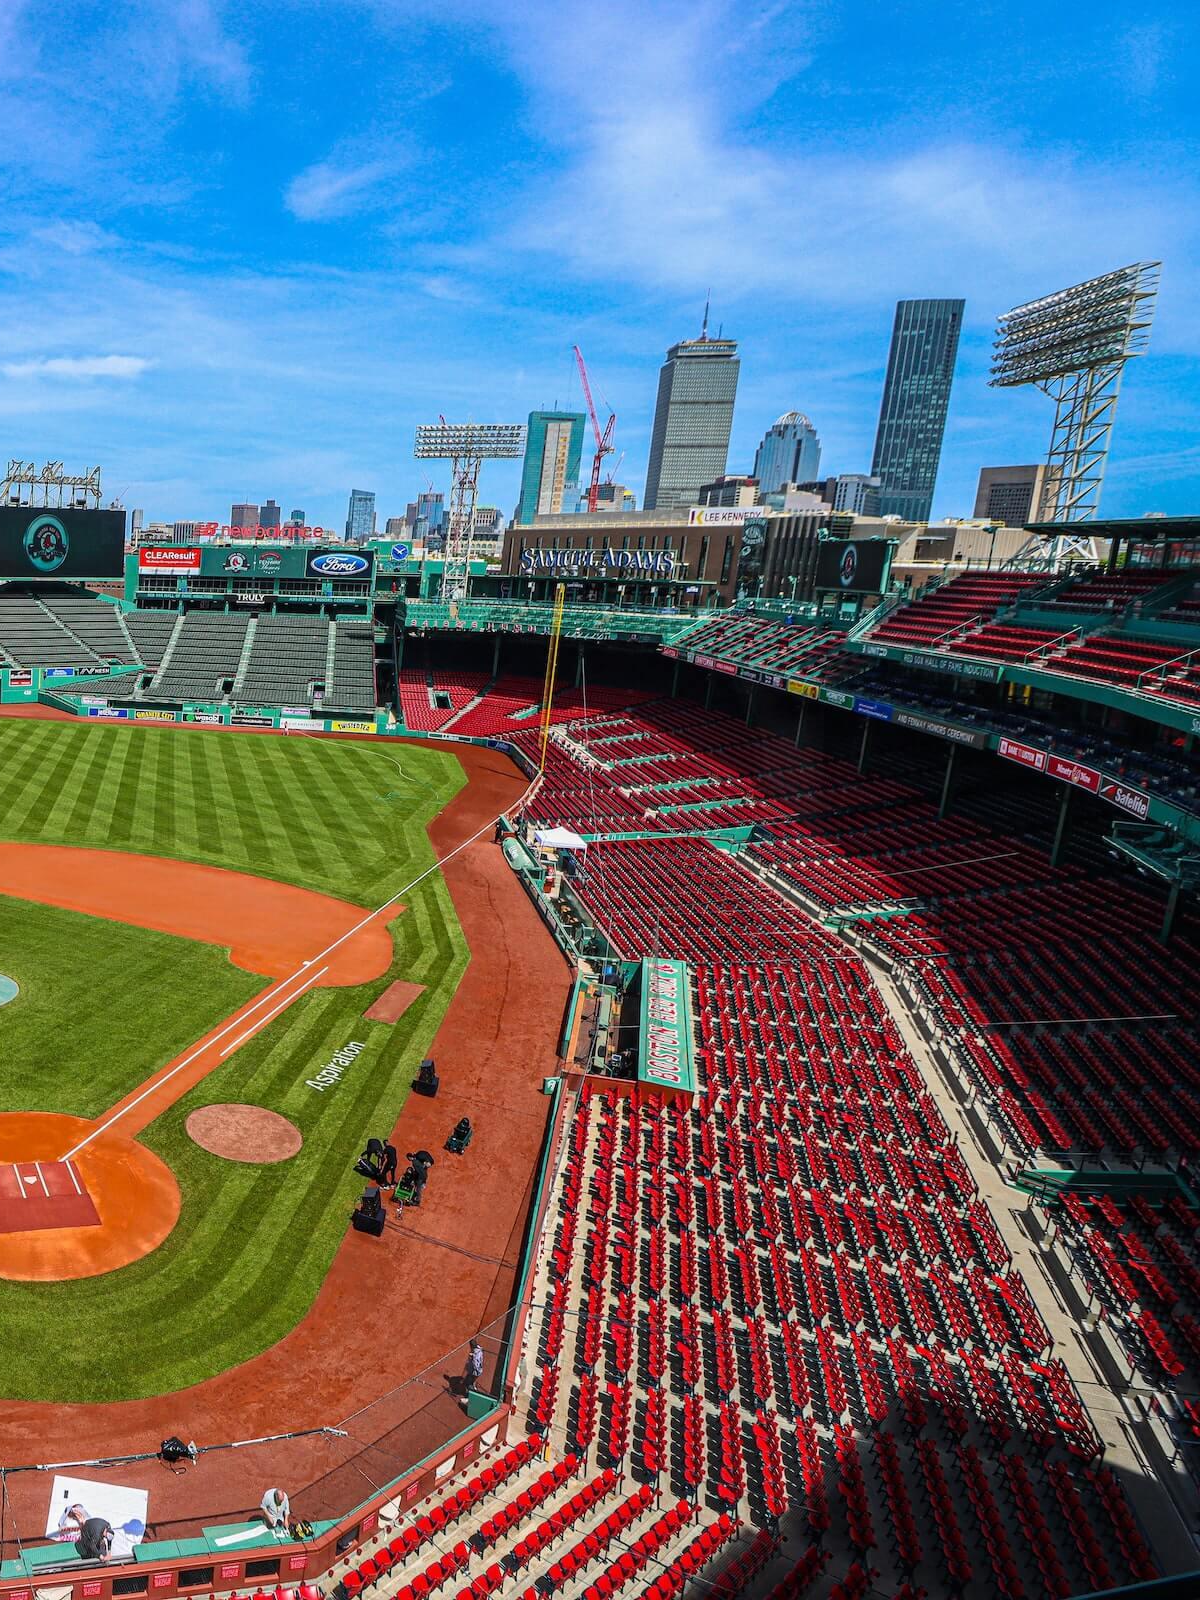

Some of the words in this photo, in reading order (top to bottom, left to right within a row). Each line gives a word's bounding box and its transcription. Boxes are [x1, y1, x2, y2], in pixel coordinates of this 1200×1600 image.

[704, 512, 719, 522] LEE
[221, 525, 252, 538] new
[255, 522, 324, 539] balance
[145, 551, 195, 560] CLEAResult
[322, 556, 356, 572] Ford
[521, 547, 599, 570] SAMUEL
[602, 547, 675, 572] ADAMS
[237, 593, 265, 602] TRULY
[903, 653, 913, 663] RED
[914, 655, 924, 665] SOX
[925, 656, 938, 667] HALL
[939, 659, 947, 669] OF
[947, 660, 962, 673] FAME
[963, 664, 994, 679] INDUCTION
[136, 711, 161, 719] GRANITE
[195, 714, 219, 722] wasabi
[897, 714, 907, 724] AND
[907, 716, 927, 730] FENWAY
[927, 720, 947, 736] HONORS
[947, 724, 975, 743] CEREMONY
[1114, 787, 1147, 815] Safelite
[648, 972, 677, 998] SOX
[647, 997, 677, 1024] RED
[647, 1024, 681, 1083] BOSTON
[305, 1041, 366, 1092] Aspiration
